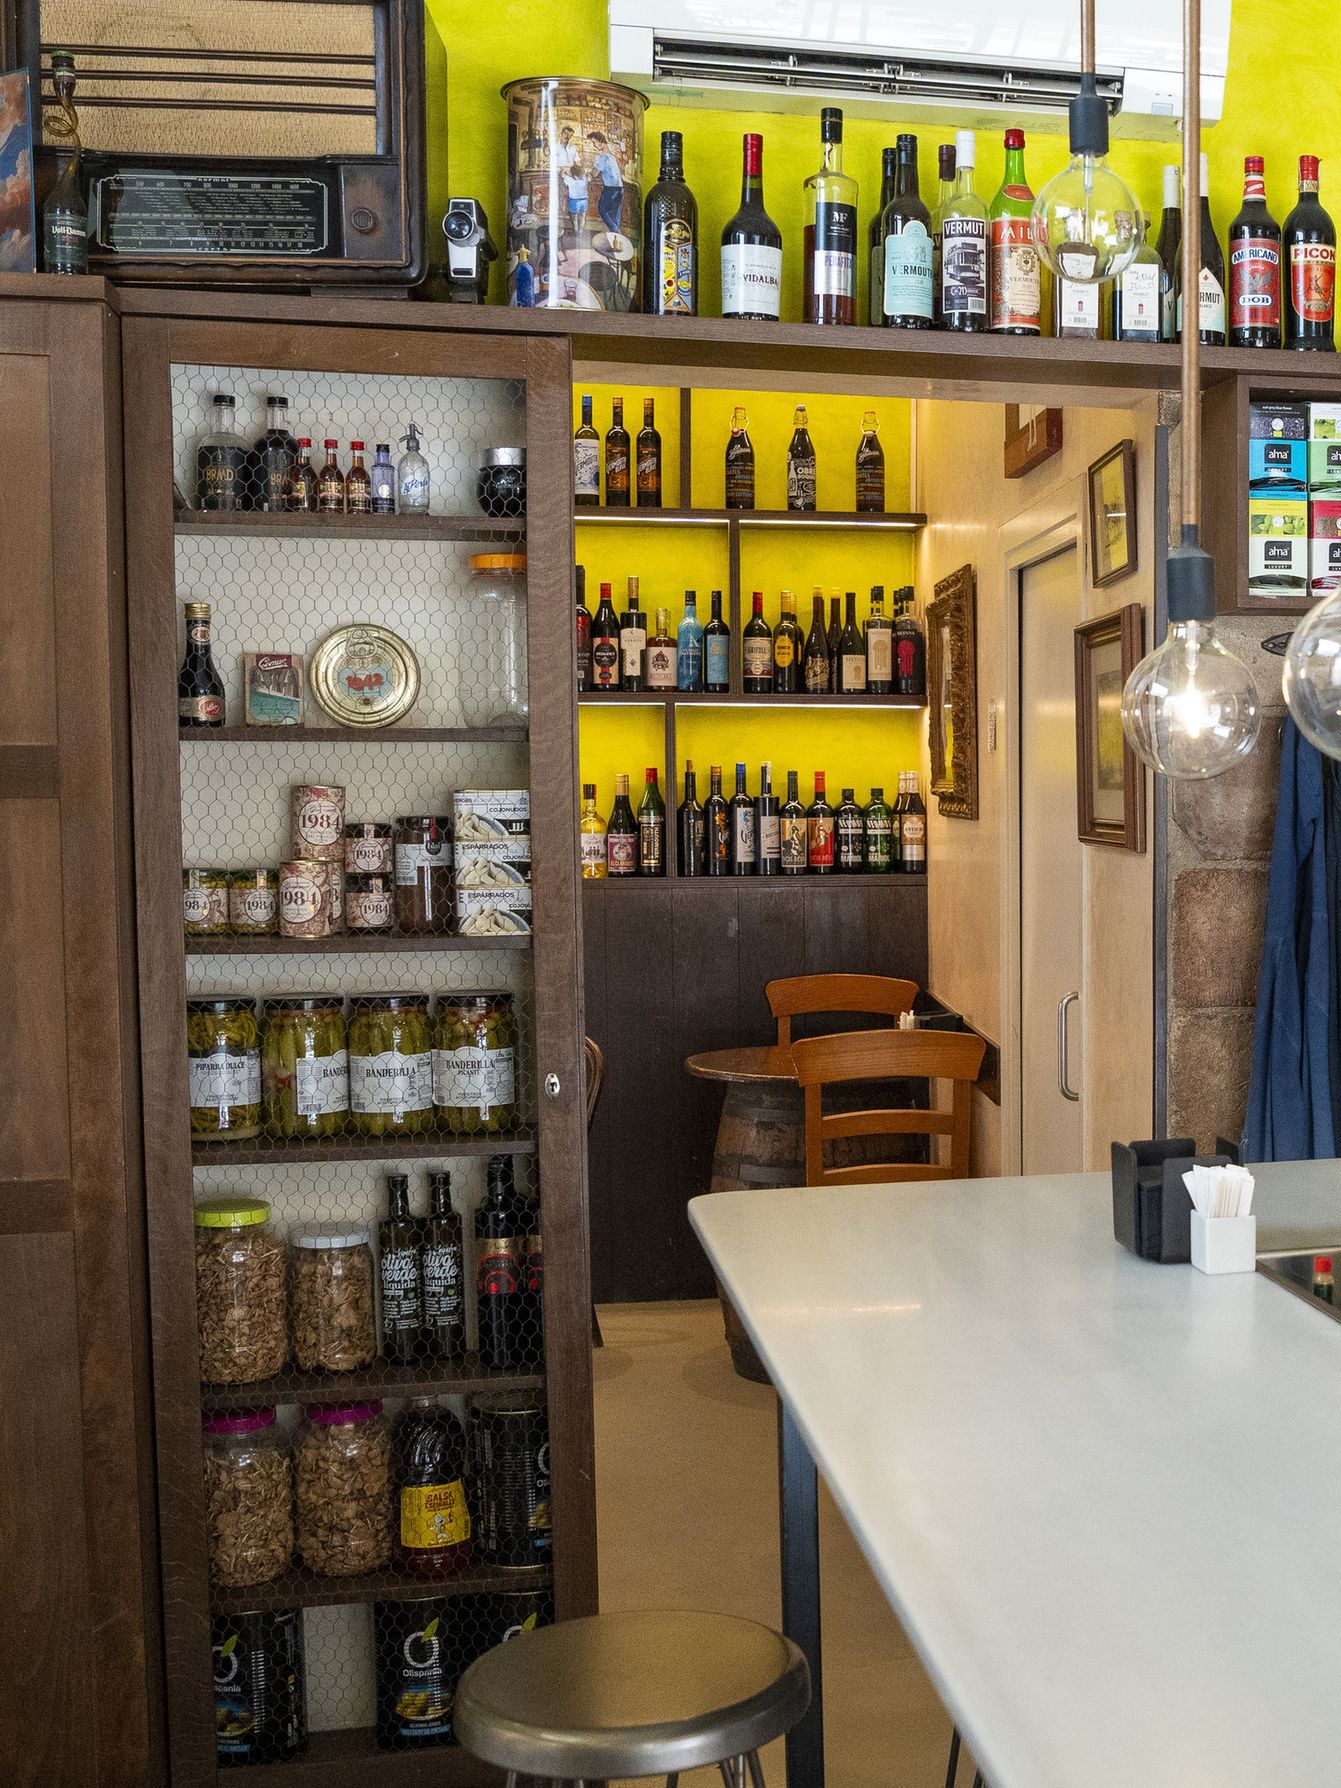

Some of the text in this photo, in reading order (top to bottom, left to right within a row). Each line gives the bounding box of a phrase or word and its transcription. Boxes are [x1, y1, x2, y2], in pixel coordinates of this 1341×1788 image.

[52, 224, 86, 238] Voll-Damm
[944, 220, 984, 236] VERMUT
[1232, 248, 1278, 264] AMERICANO
[1293, 246, 1336, 261] PICON
[1199, 291, 1221, 305] RMUT
[1268, 450, 1288, 460] alma
[1268, 546, 1288, 557] alma
[488, 806, 528, 814] COJONUDOS
[301, 814, 341, 830] 1984
[356, 849, 382, 860] 1984
[281, 890, 318, 906] 1984
[184, 900, 208, 912] 984
[246, 900, 274, 912] 1984
[363, 904, 389, 916] 1984
[225, 1061, 246, 1070] DULCE
[446, 1060, 496, 1070] BANDERILLA
[365, 1067, 417, 1078] BANDERILLA
[381, 1254, 415, 1271] oliva
[422, 1252, 455, 1268] oliva
[381, 1266, 418, 1282] verde
[422, 1264, 458, 1278] verde
[214, 1684, 242, 1694] spania
